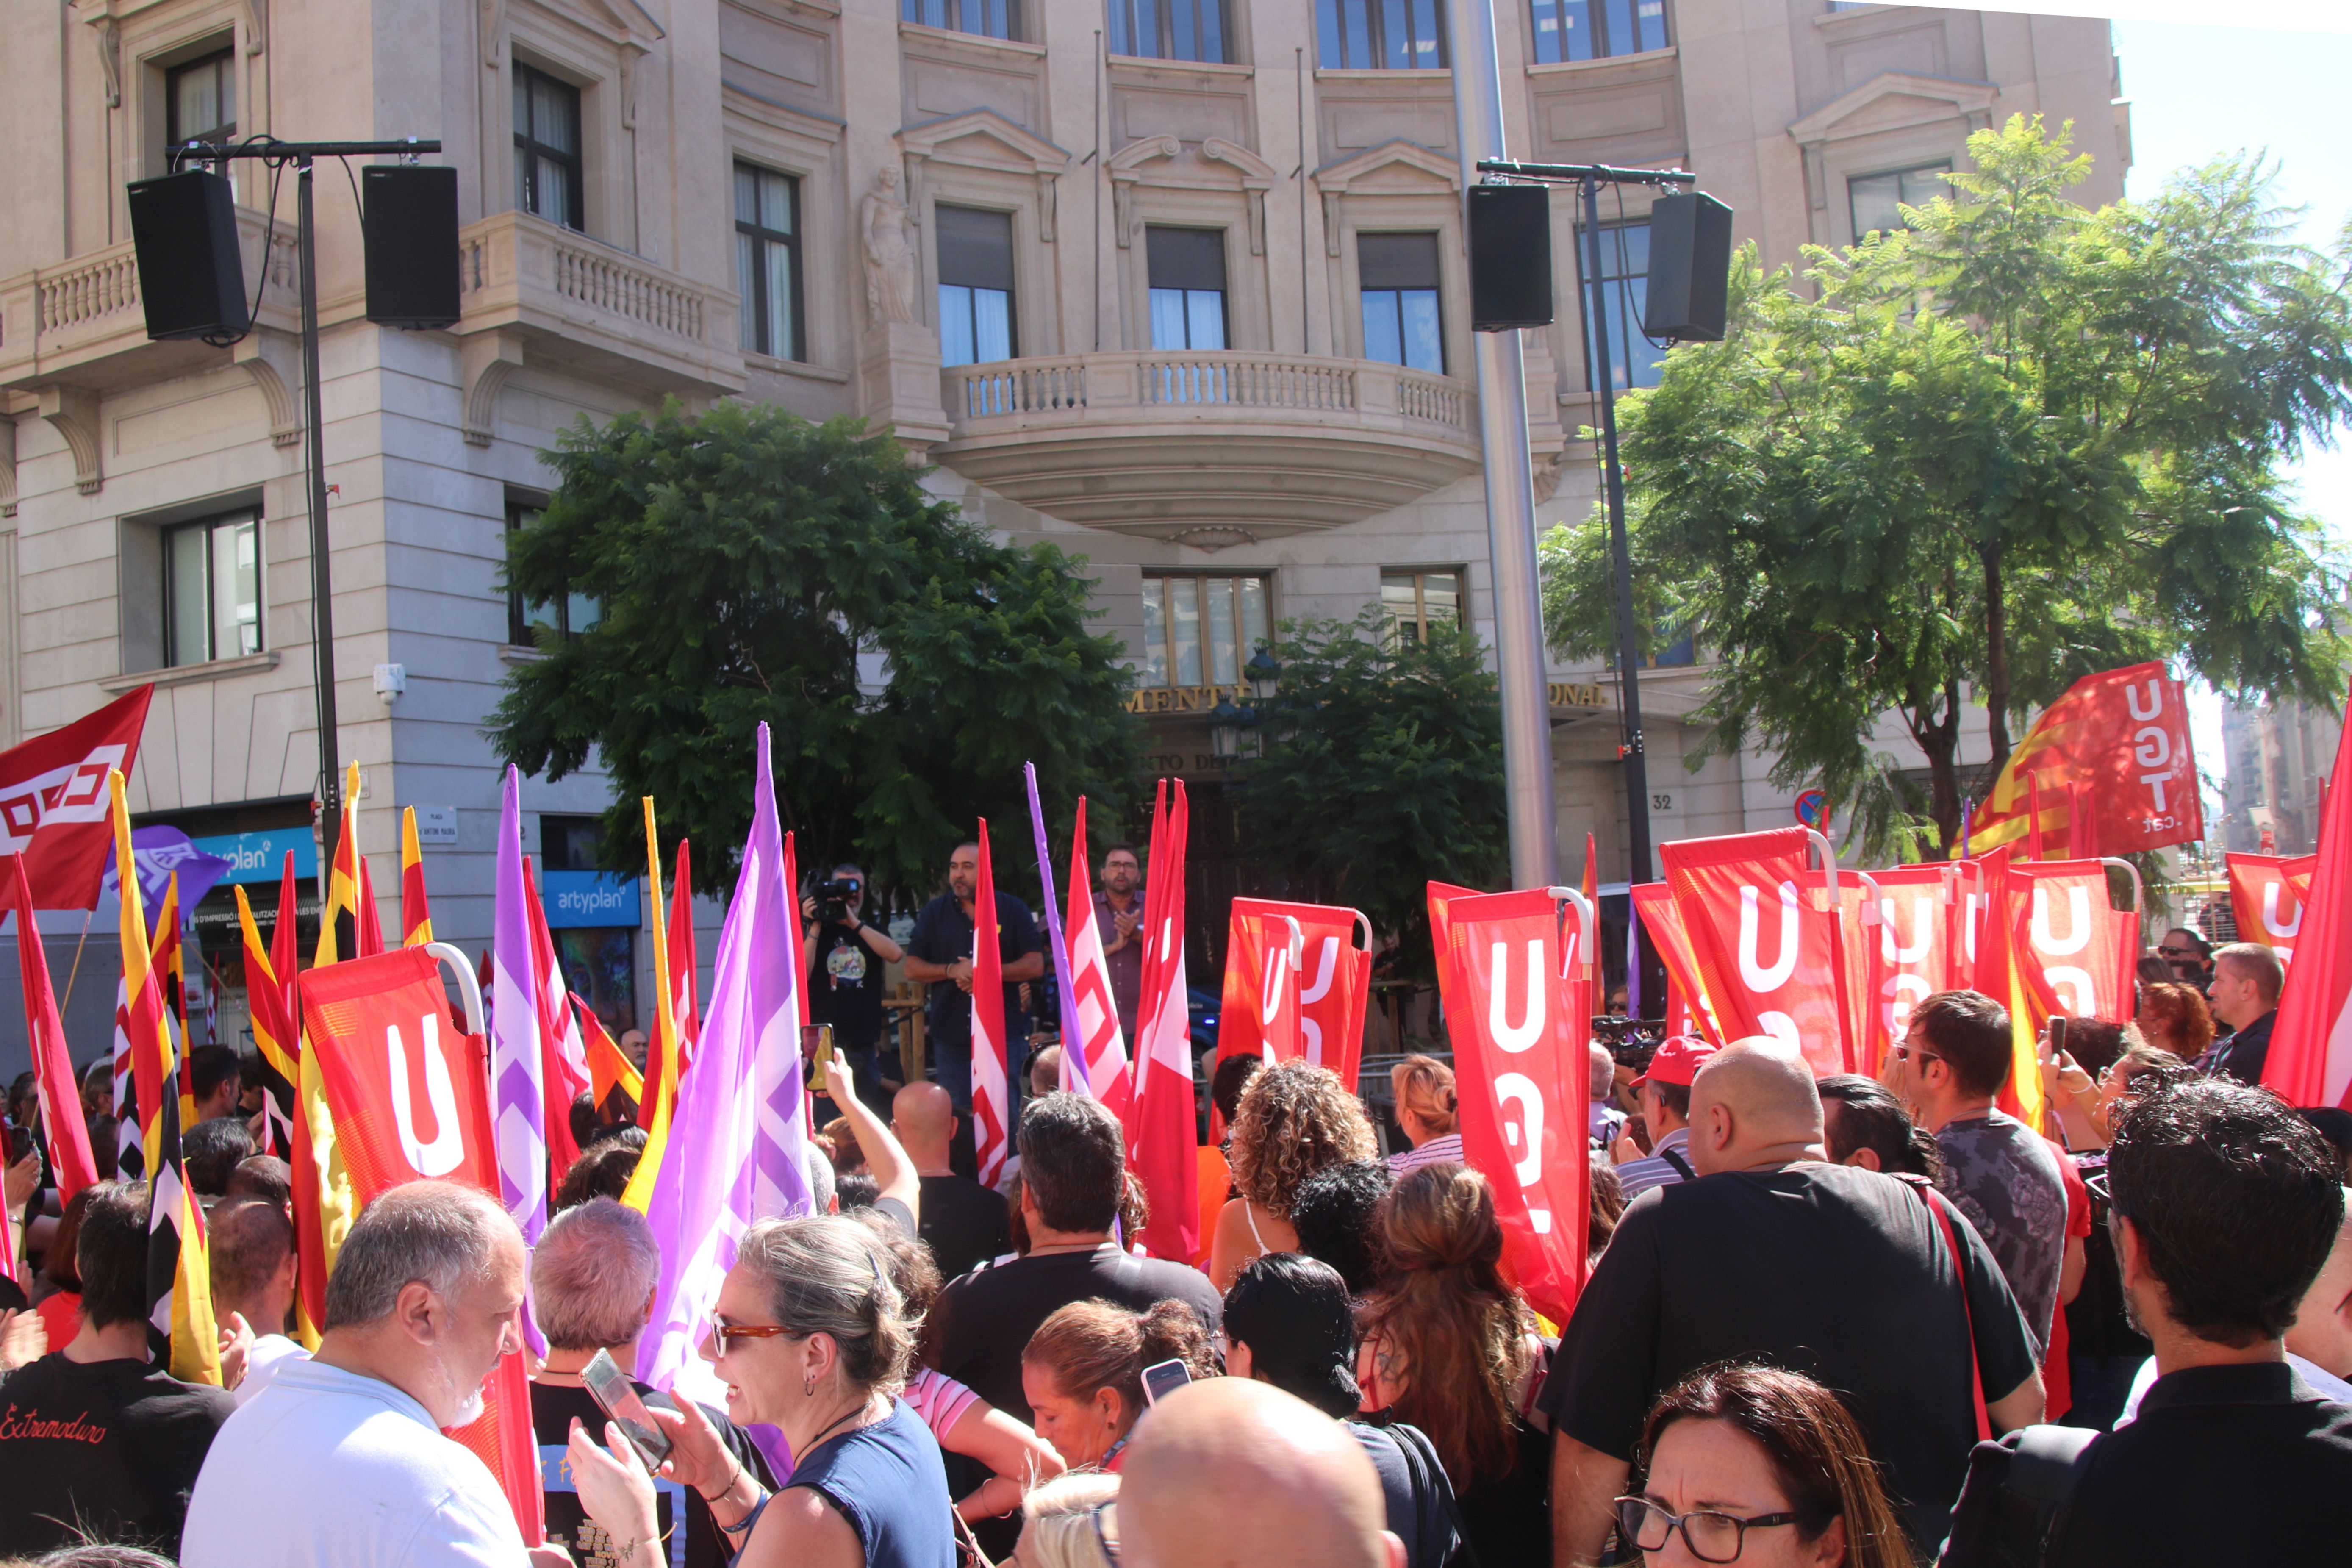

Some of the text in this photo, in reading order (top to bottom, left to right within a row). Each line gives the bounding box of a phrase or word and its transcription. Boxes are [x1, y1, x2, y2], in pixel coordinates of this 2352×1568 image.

[1119, 685, 1224, 713] MENT
[1547, 683, 1609, 706] ONAL
[1653, 795, 1671, 810] 32
[558, 886, 622, 914] artyplan
[0, 1402, 107, 1444] Extremoduro
[595, 1551, 617, 1559] NOVE
